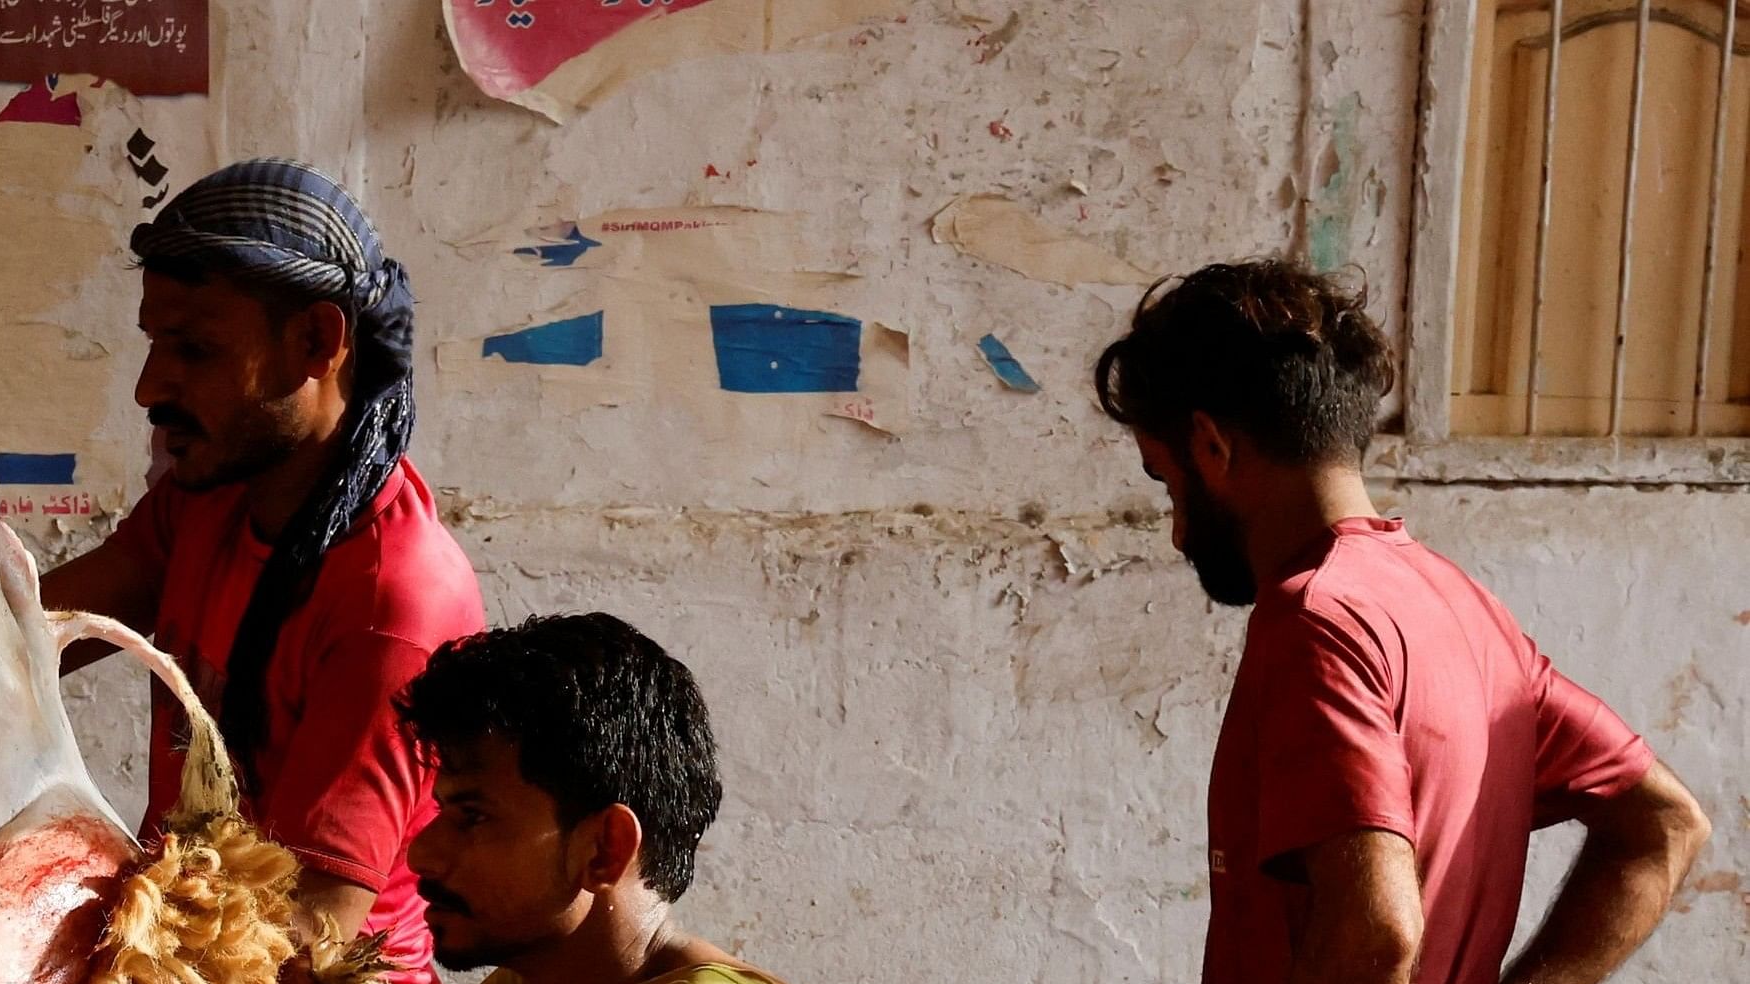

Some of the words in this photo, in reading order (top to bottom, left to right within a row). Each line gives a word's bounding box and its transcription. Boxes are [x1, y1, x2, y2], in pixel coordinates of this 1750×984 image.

[63, 5, 111, 48] فلسطینی
[99, 10, 129, 44] دیگر
[129, 24, 148, 44] اور
[147, 17, 187, 54] پوتوں
[42, 492, 90, 515] ڈاکٹر
